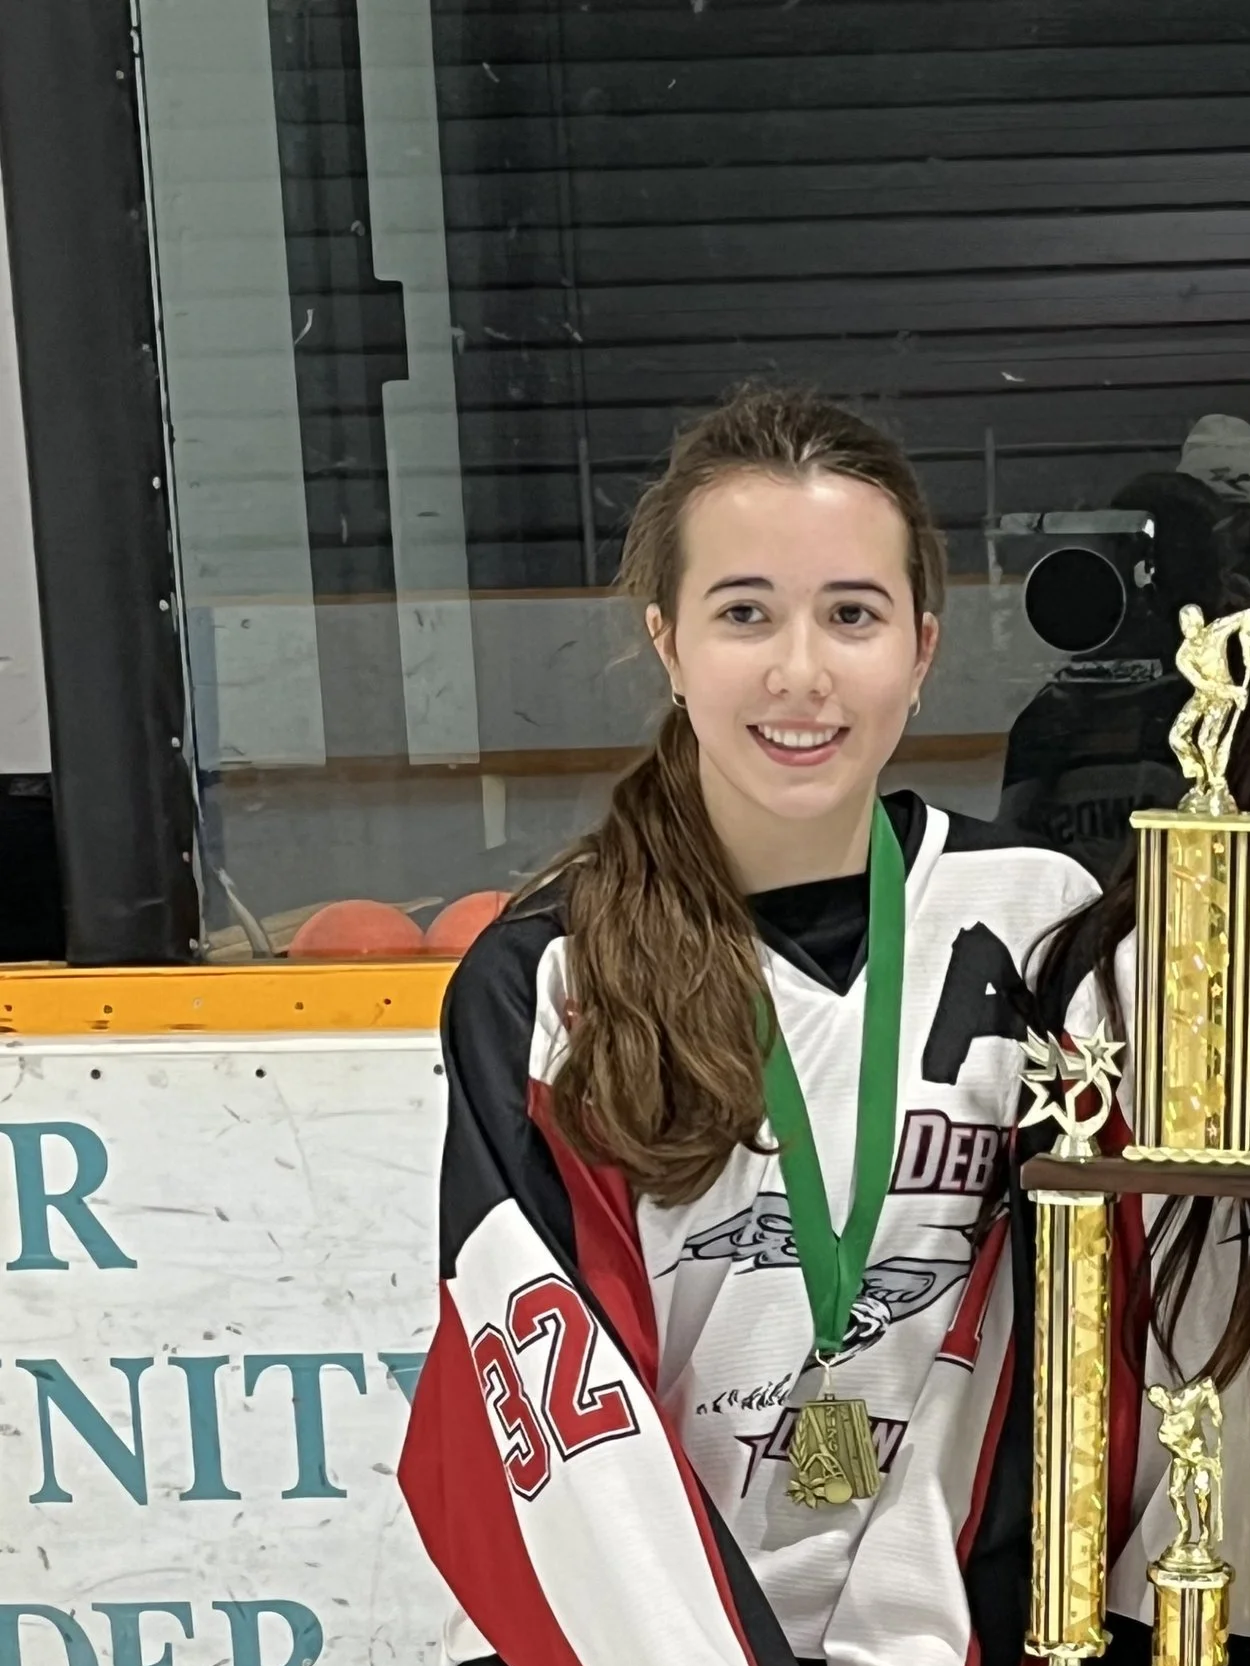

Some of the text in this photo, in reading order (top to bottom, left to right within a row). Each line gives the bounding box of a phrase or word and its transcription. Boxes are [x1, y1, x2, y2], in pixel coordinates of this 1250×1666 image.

[921, 921, 1030, 1086] A
[0, 1121, 138, 1271] R
[890, 1108, 1014, 1195] DEB
[471, 1272, 641, 1502] 32
